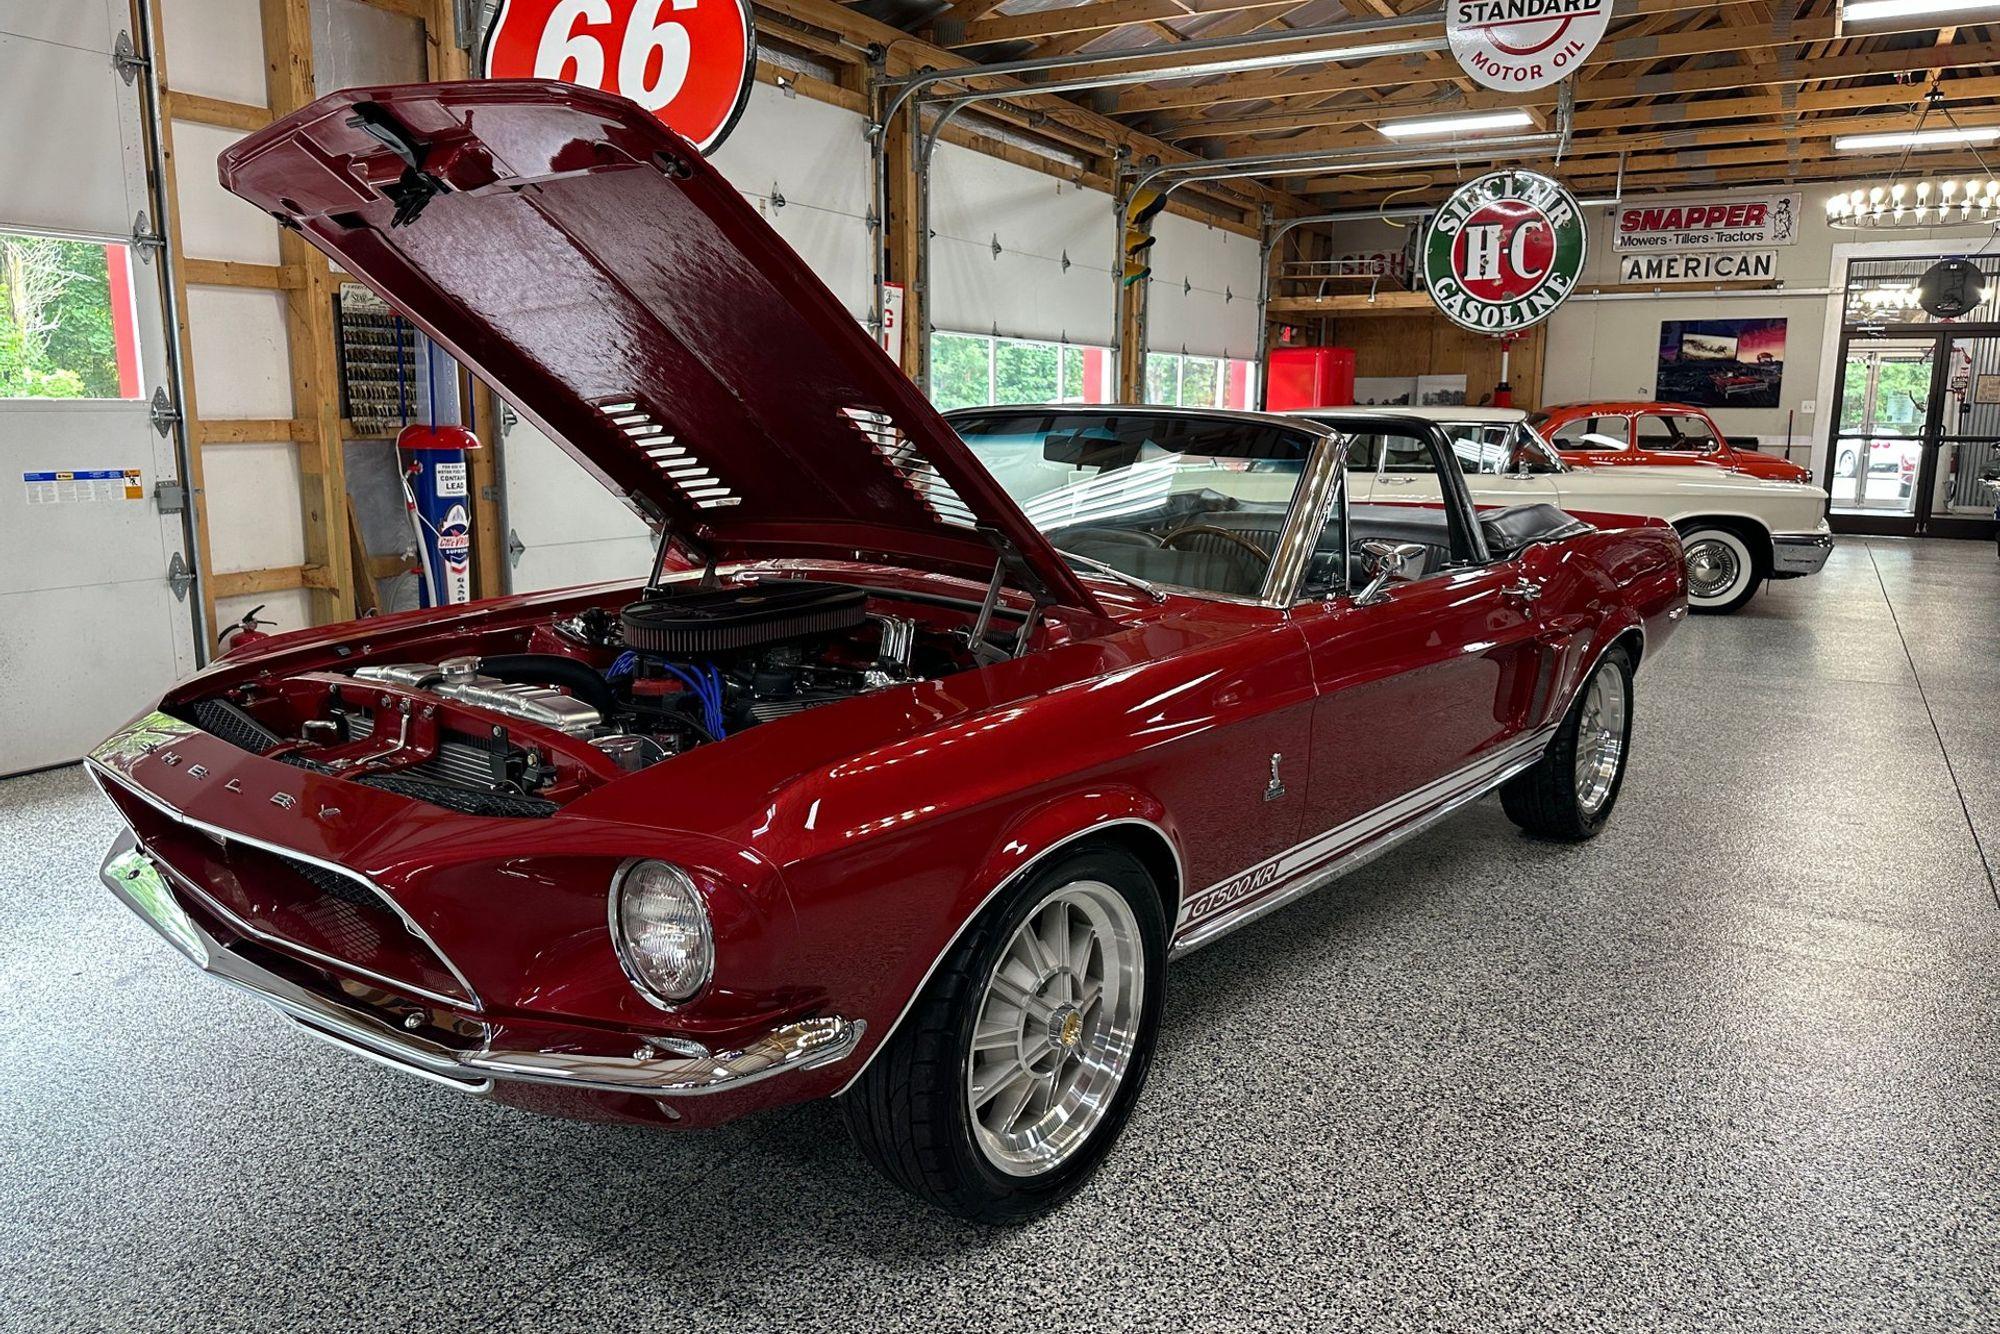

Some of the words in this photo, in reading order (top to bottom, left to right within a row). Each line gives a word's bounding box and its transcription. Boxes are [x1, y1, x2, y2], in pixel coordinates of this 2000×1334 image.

[1458, 0, 1601, 24] STANDARD
[534, 0, 698, 112] 66
[1470, 50, 1544, 82] MOTOR
[1552, 40, 1586, 67] OIL
[1437, 175, 1573, 237] SINCLAIR
[1619, 202, 1768, 232] SNAPPER
[1619, 236, 1668, 248] Mowers
[1673, 232, 1710, 245] Tillers
[1715, 231, 1764, 243] Tractors
[1627, 254, 1772, 280] AMERICAN
[1434, 271, 1572, 328] GASOLINE
